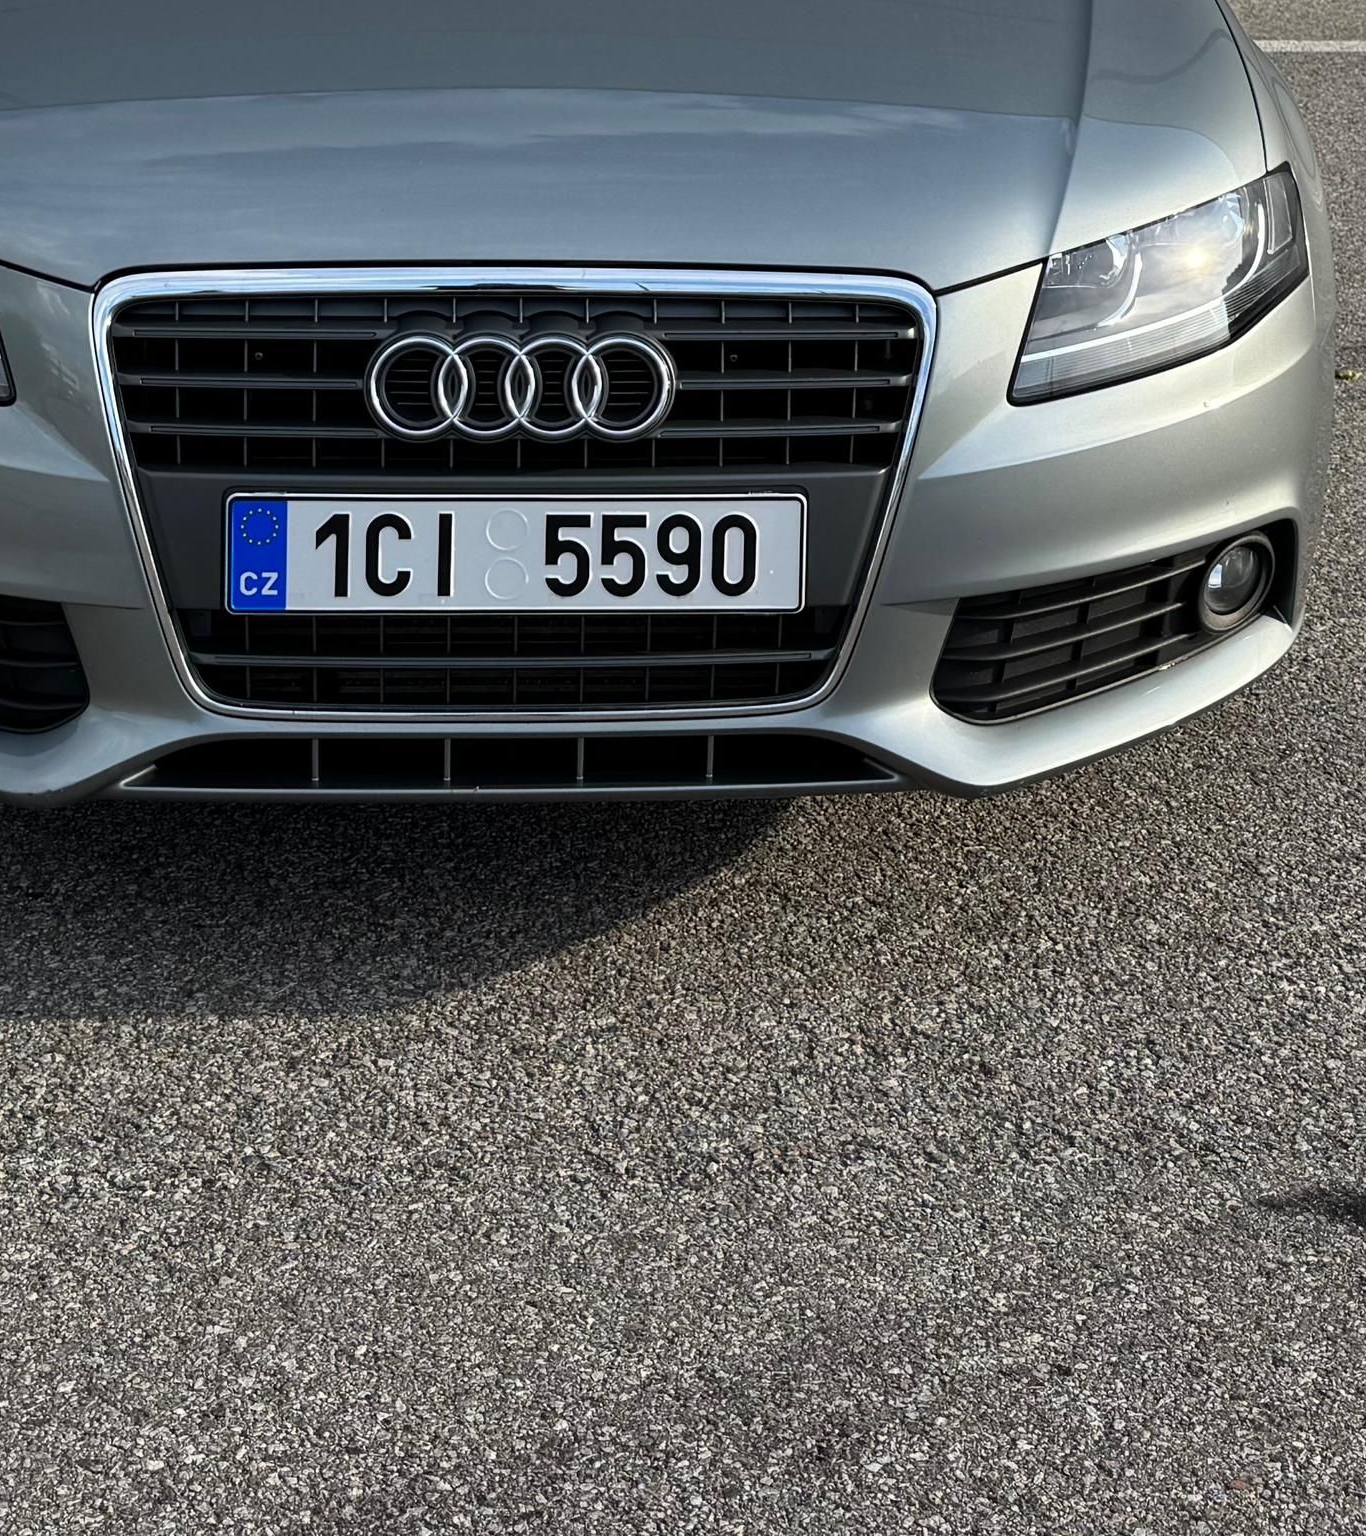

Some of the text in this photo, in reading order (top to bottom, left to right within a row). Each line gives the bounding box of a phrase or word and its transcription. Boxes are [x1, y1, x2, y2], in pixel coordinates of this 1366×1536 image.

[315, 513, 757, 598] 1CI 5590
[239, 571, 279, 596] CZ
